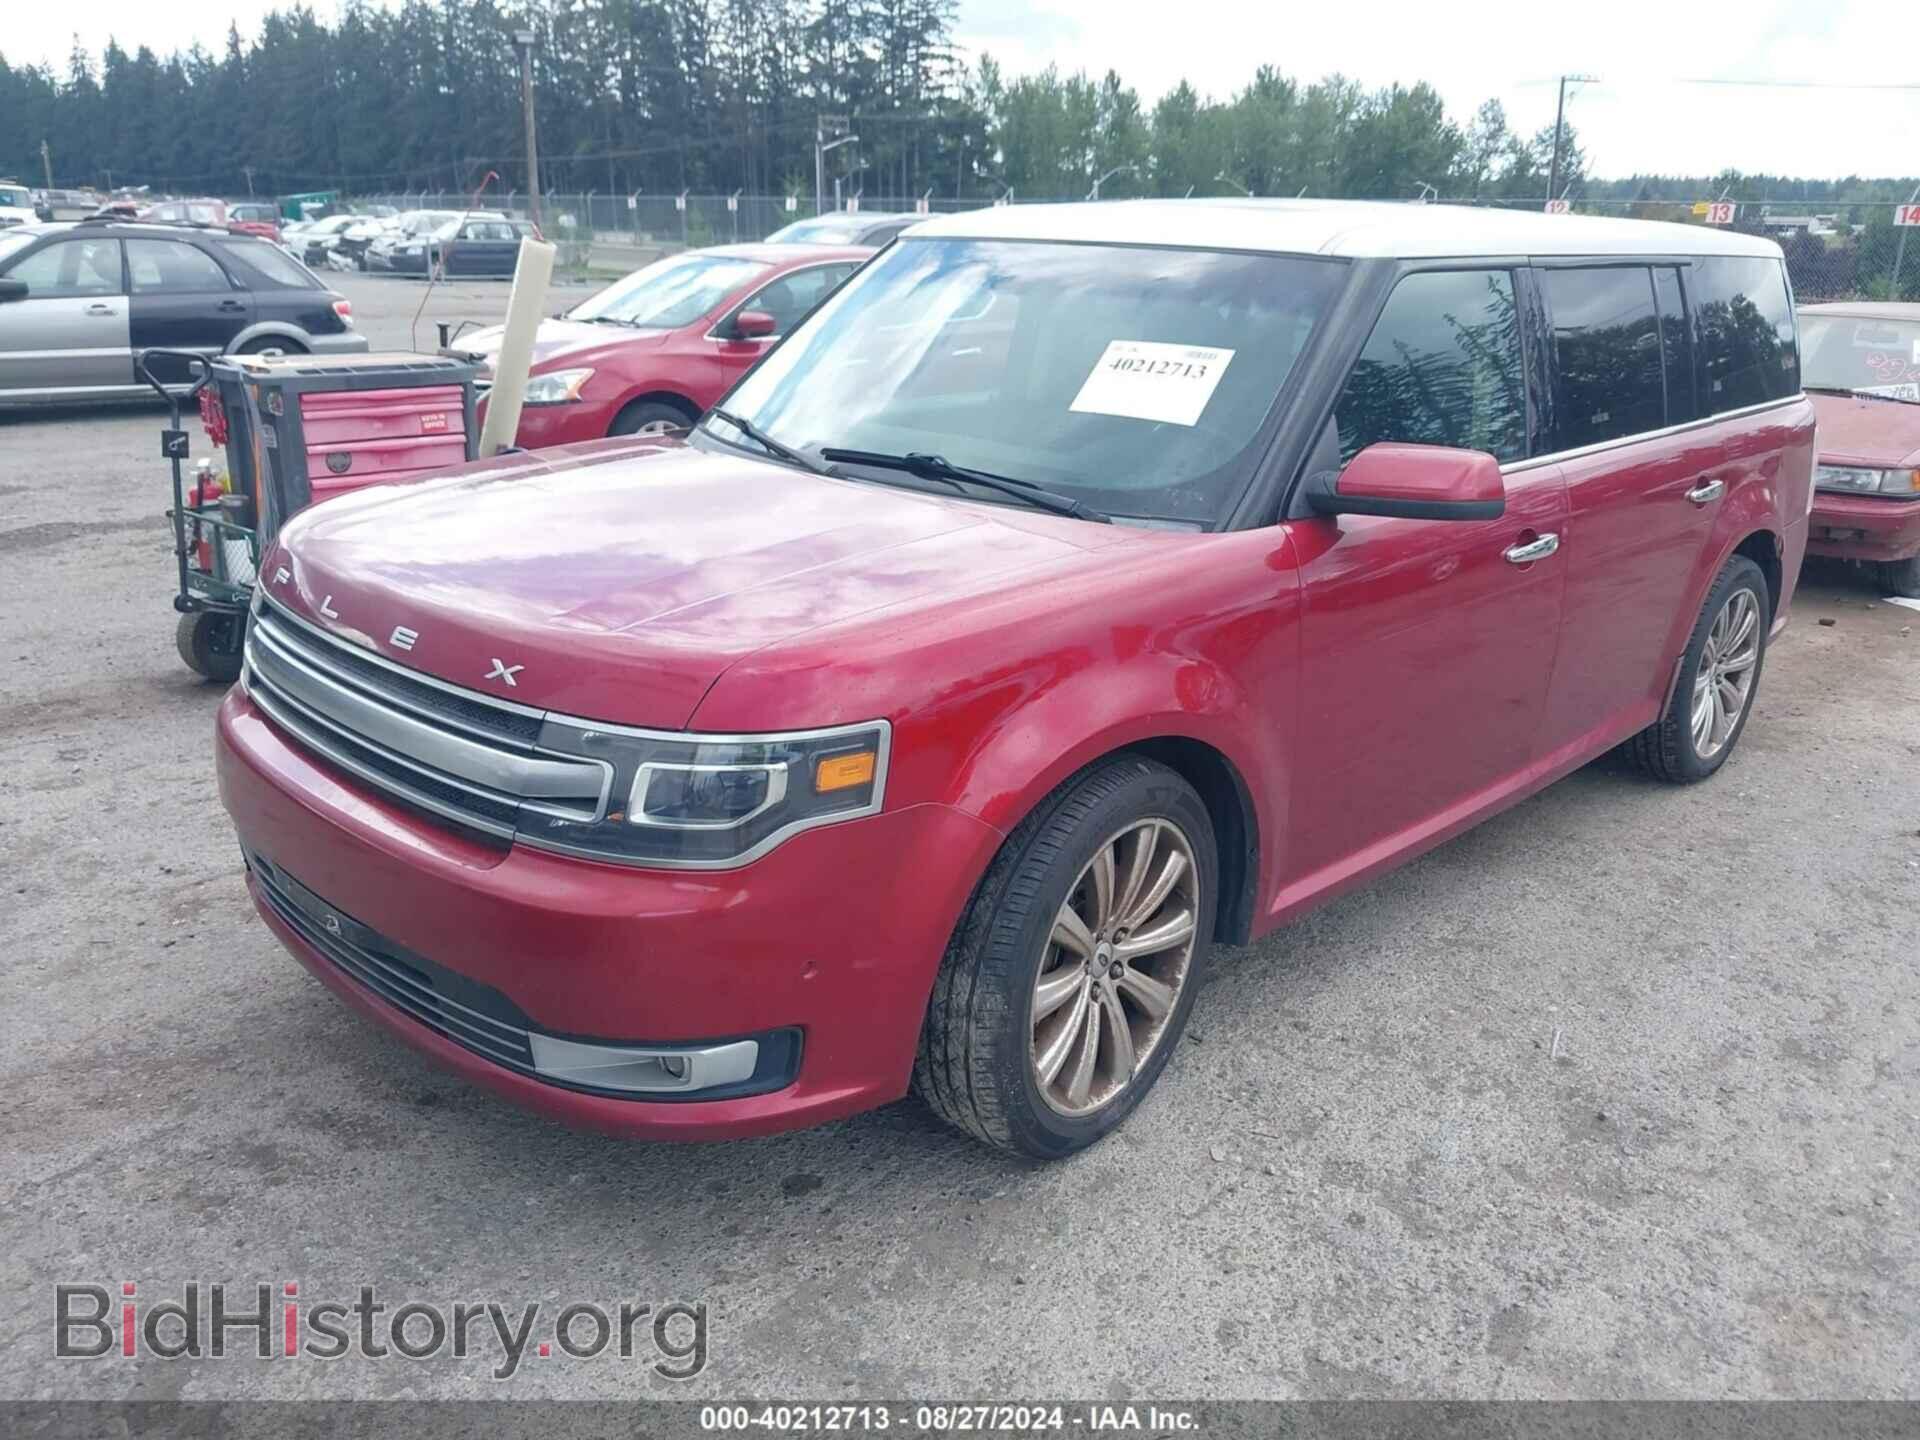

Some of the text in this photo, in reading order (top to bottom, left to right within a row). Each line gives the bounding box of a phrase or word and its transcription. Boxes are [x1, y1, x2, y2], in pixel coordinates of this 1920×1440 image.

[1710, 204, 1730, 221] 13
[1901, 206, 1920, 224] 14
[1109, 357, 1207, 378] 40212713
[273, 567, 525, 686] FLEX
